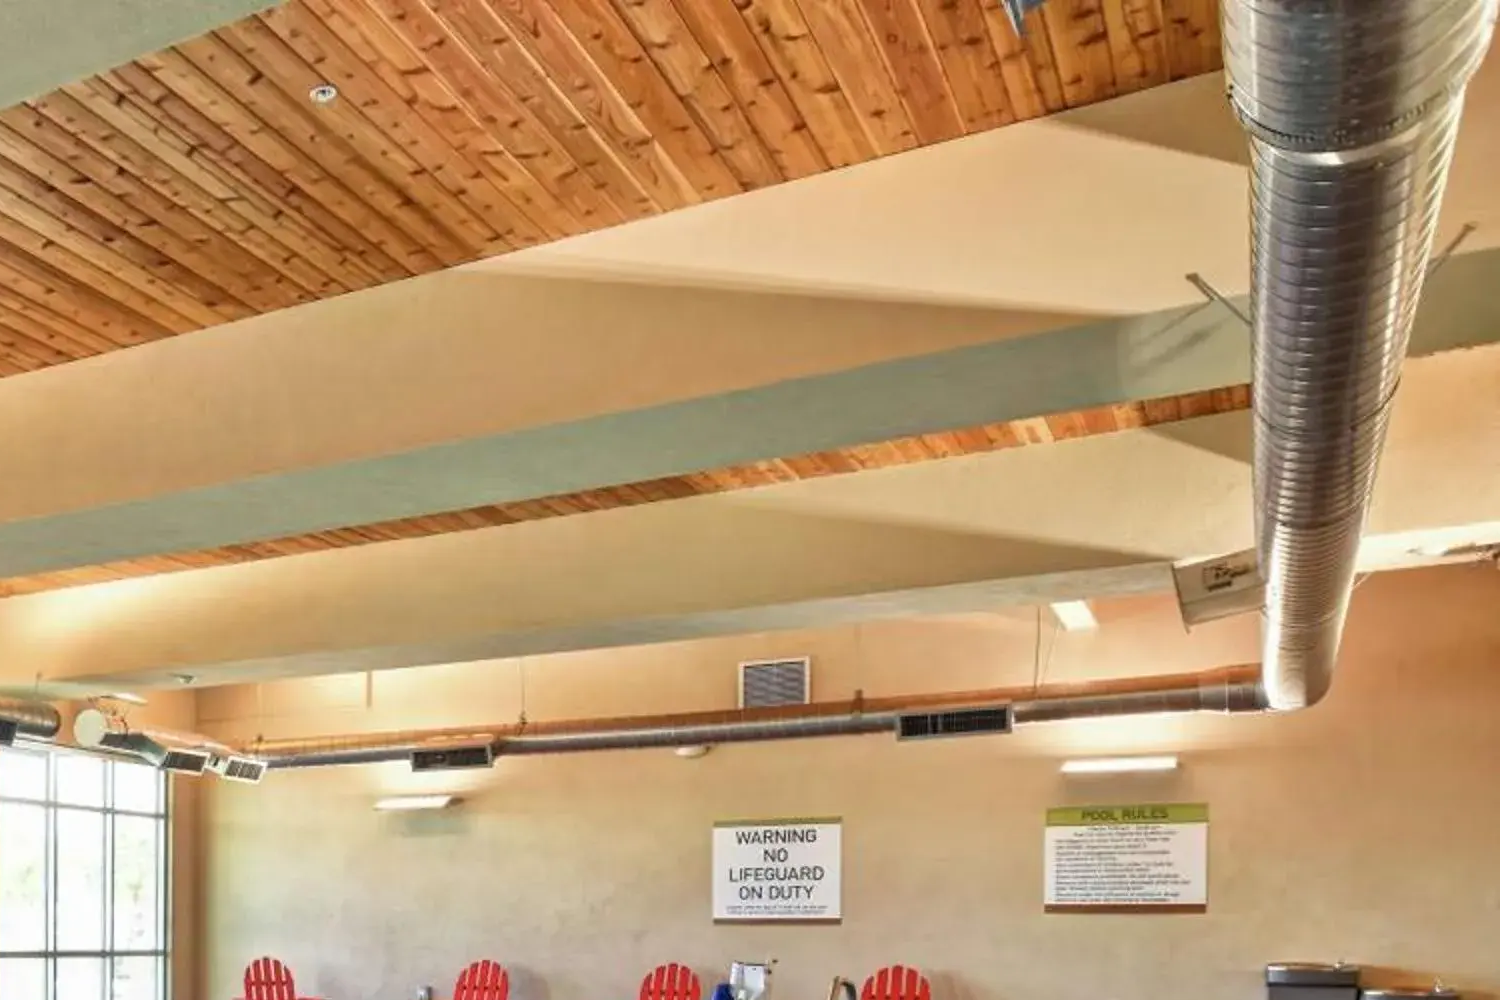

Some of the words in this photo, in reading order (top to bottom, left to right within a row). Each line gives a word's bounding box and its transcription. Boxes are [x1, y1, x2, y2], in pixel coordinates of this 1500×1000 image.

[1081, 809, 1118, 821] POOL
[1122, 807, 1169, 820] RULES
[735, 829, 817, 845] WARNING
[763, 848, 789, 862] NO
[729, 866, 825, 882] LIFEGUARD
[739, 886, 763, 900] ON
[768, 885, 814, 900] DUTY
